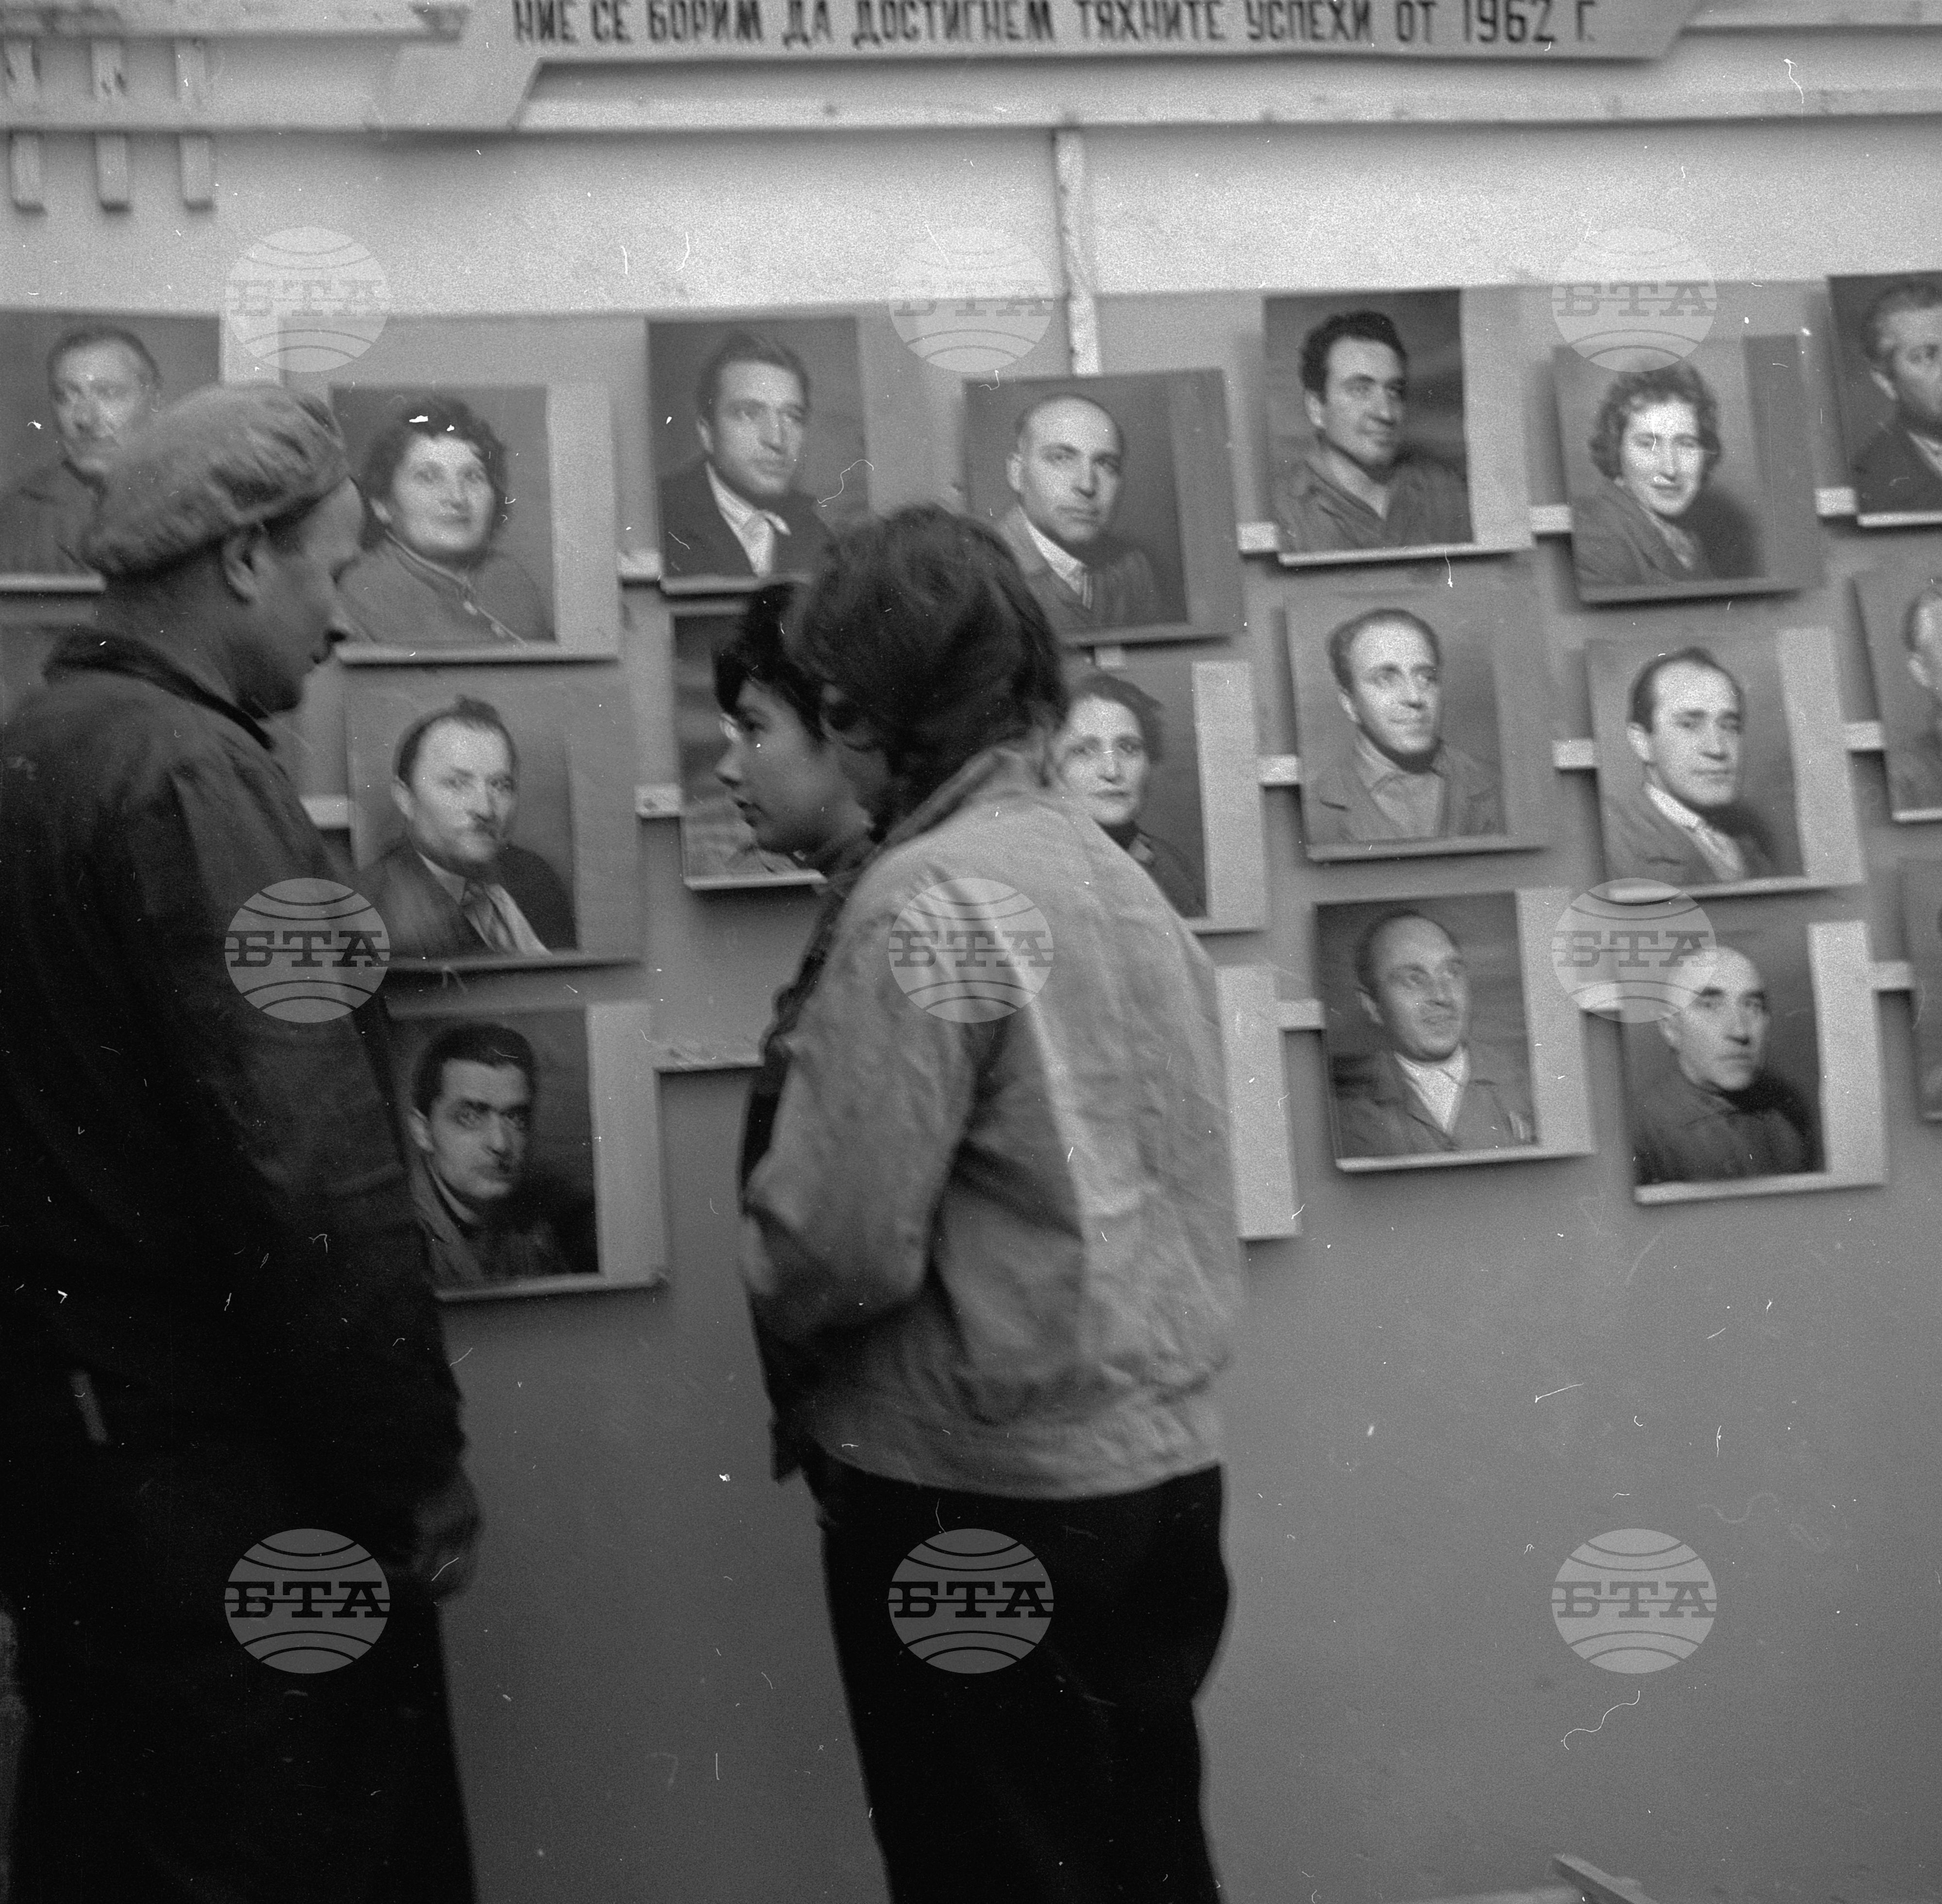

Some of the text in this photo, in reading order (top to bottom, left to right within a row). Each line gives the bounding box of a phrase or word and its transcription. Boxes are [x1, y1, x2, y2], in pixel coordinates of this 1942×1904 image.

[512, 0, 579, 42] НИЕ
[590, 0, 633, 43] СЕ
[647, 0, 763, 41] БОРИМ
[780, 0, 833, 47] ДА
[853, 0, 1055, 47] ДОСТИГНЕМ
[1076, 0, 1226, 41] ТЯХНИТЕ
[1245, 0, 1372, 42] УСПЕХИ
[1396, 0, 1437, 44] ОТ
[1462, 0, 1556, 43] 1962
